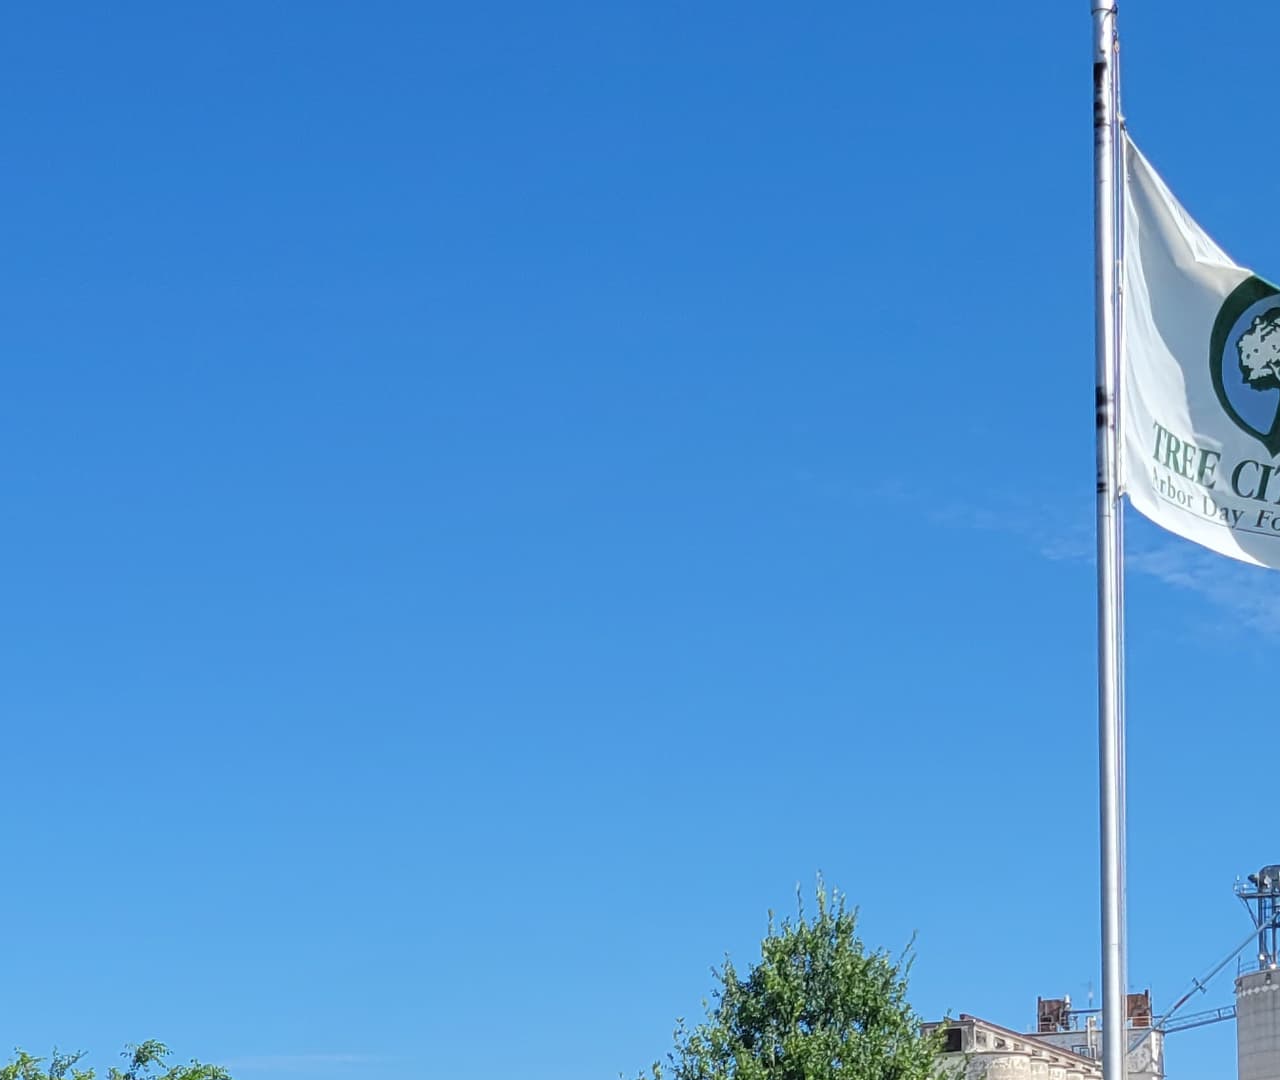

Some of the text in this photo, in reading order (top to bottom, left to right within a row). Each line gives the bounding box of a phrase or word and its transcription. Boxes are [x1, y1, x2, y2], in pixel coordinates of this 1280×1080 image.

[1152, 420, 1221, 489] TREE
[1152, 466, 1194, 508] Arbor
[1202, 494, 1245, 529] Day
